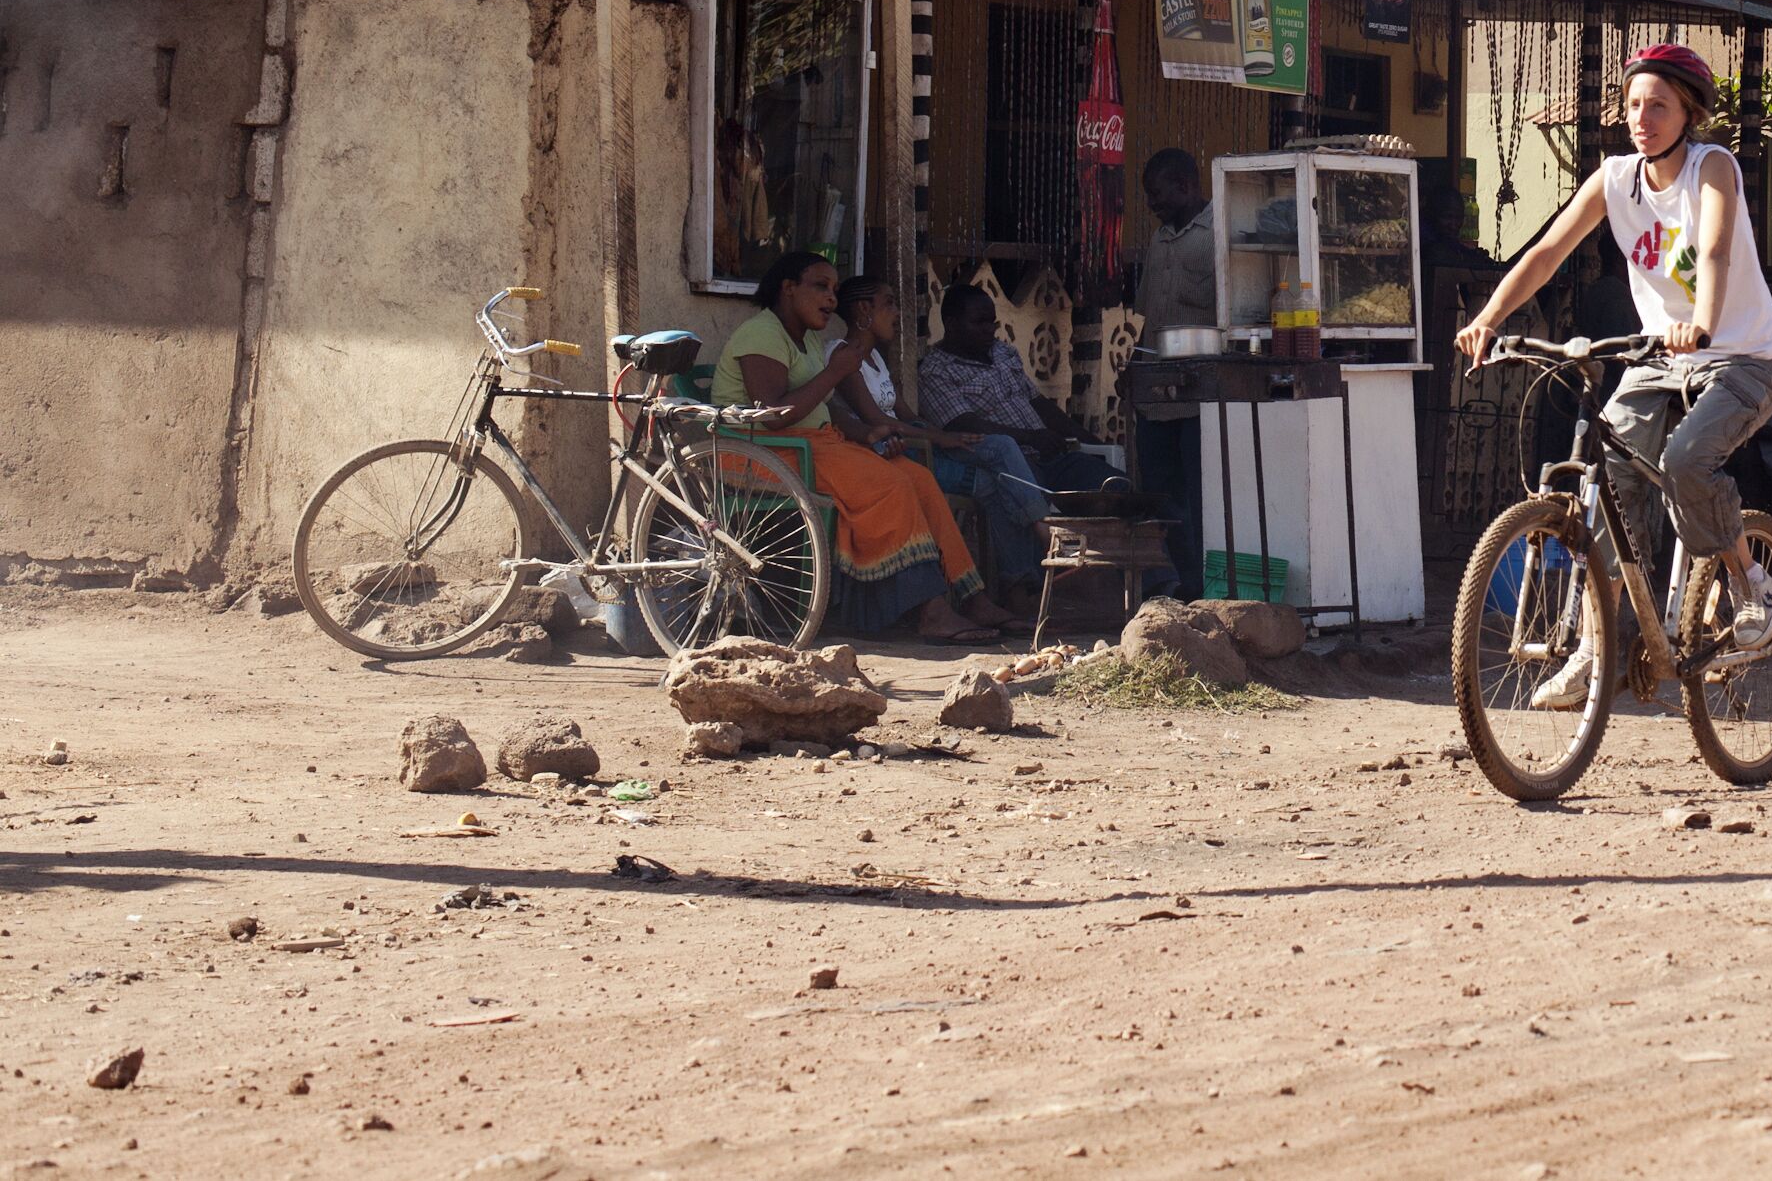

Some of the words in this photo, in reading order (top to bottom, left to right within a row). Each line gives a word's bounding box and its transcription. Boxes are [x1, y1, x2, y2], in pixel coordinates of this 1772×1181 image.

[1275, 5, 1303, 18] PINEAPPLE
[1163, 16, 1178, 33] MILK
[1178, 9, 1196, 24] STOUT
[1275, 17, 1304, 29] FLAVOURED
[1281, 28, 1298, 38] SPIRIT
[1077, 111, 1124, 152] Coca-Cola
